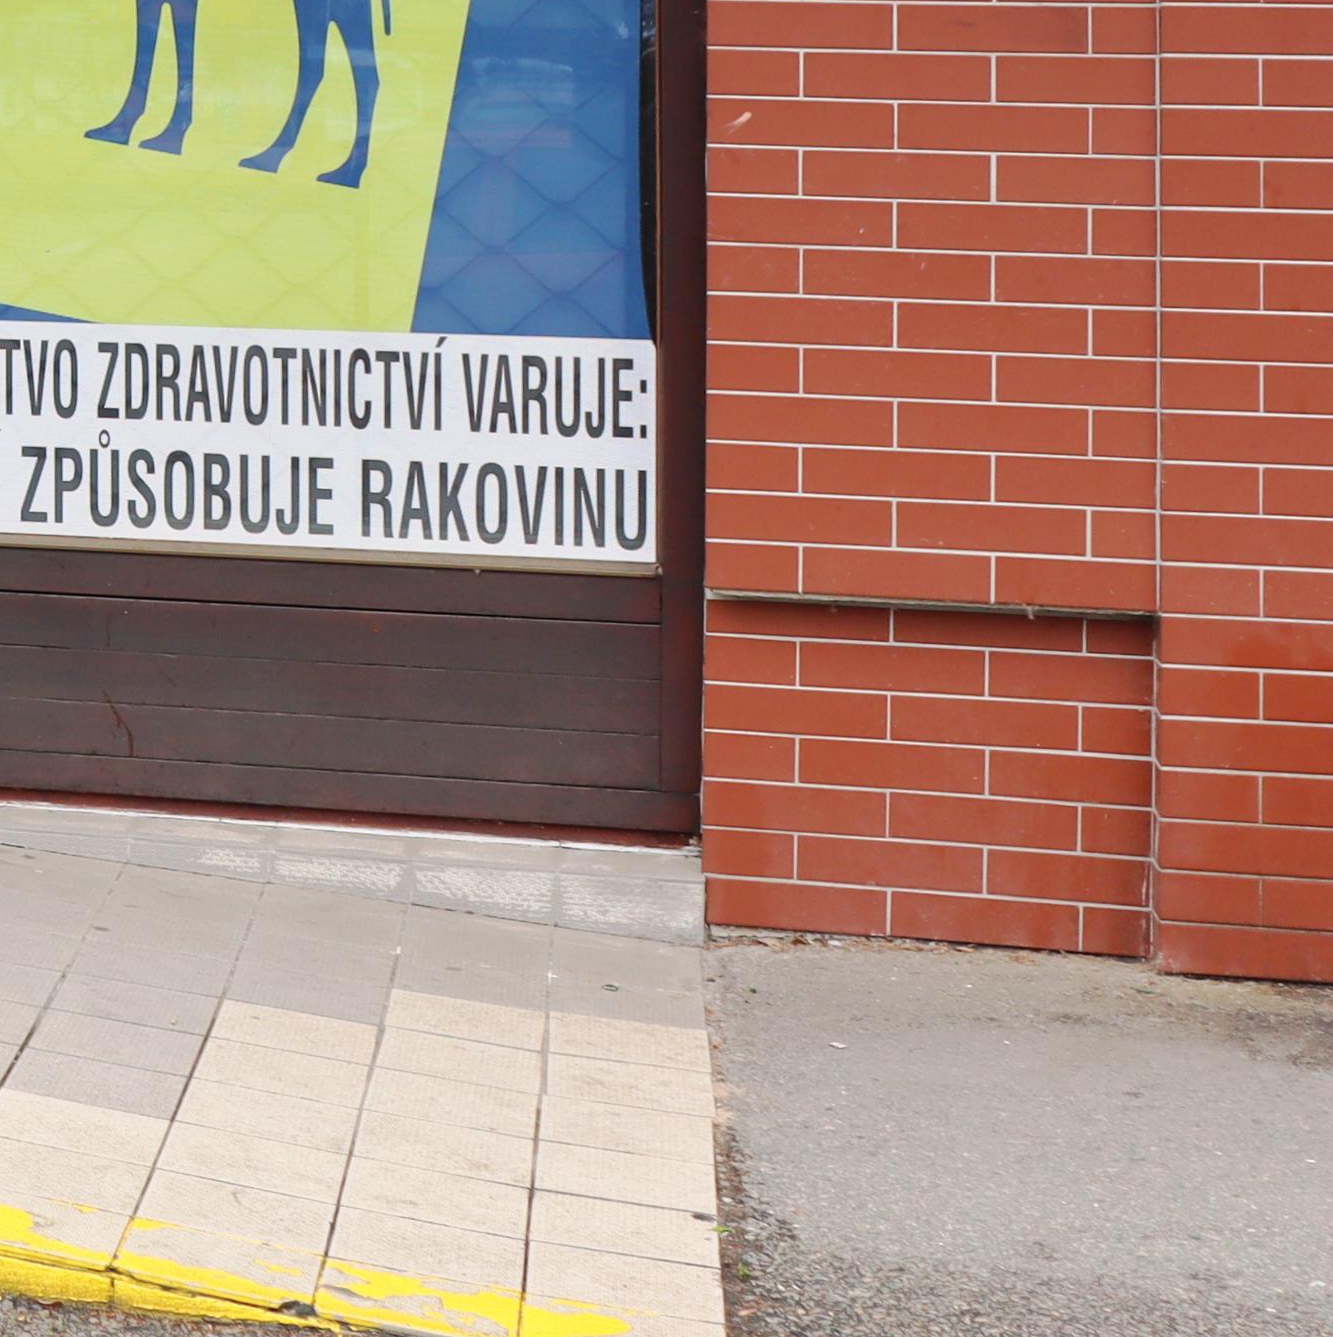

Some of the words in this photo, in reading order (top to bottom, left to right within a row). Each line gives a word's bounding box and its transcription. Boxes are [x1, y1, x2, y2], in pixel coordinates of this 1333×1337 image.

[96, 336, 444, 432] ZDRAVOTNICTVÍ
[462, 354, 649, 440] VARUJE:
[20, 429, 336, 536] ZPŮSOBUJE
[361, 459, 649, 551] RAKOVINU
